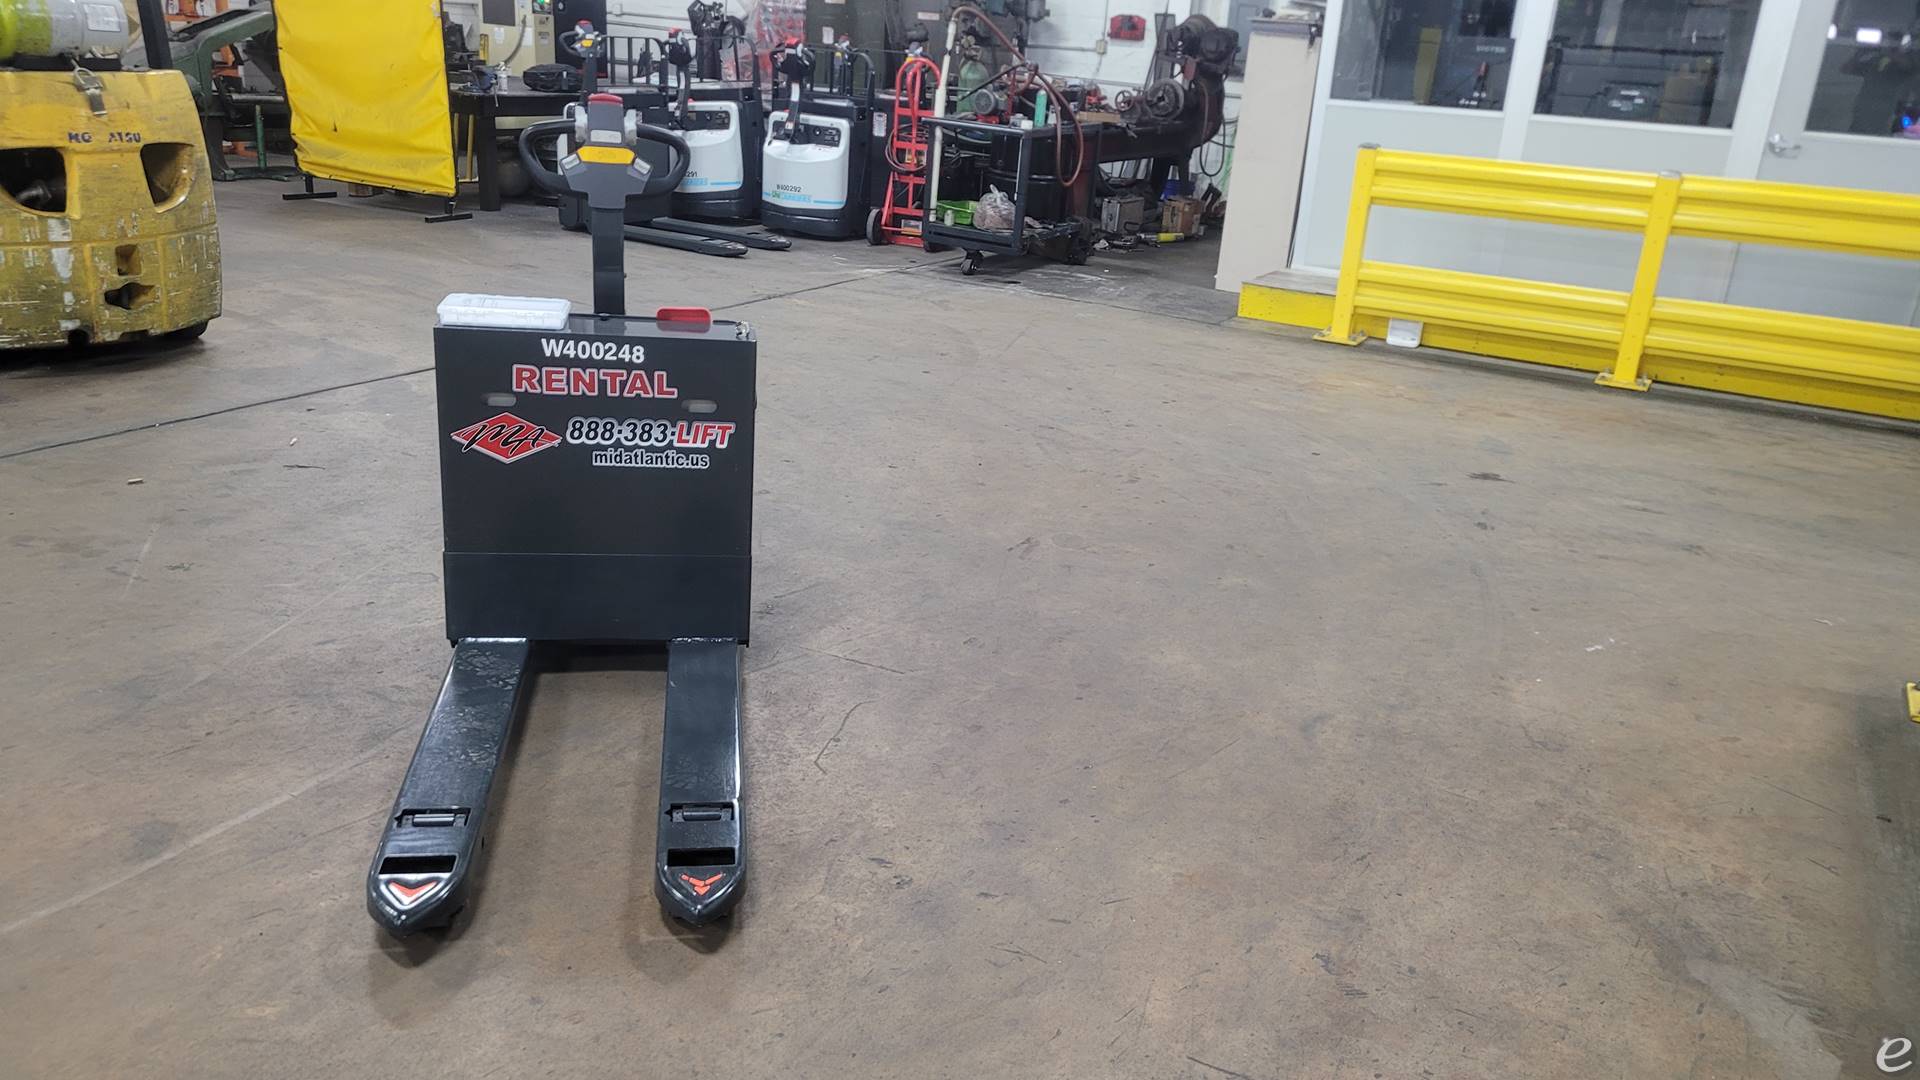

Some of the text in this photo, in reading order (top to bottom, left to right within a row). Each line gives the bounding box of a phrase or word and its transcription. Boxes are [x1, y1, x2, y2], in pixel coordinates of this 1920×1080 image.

[541, 338, 645, 364] W400248
[512, 364, 678, 399] RENTAL
[592, 448, 710, 469] midatlantic.us
